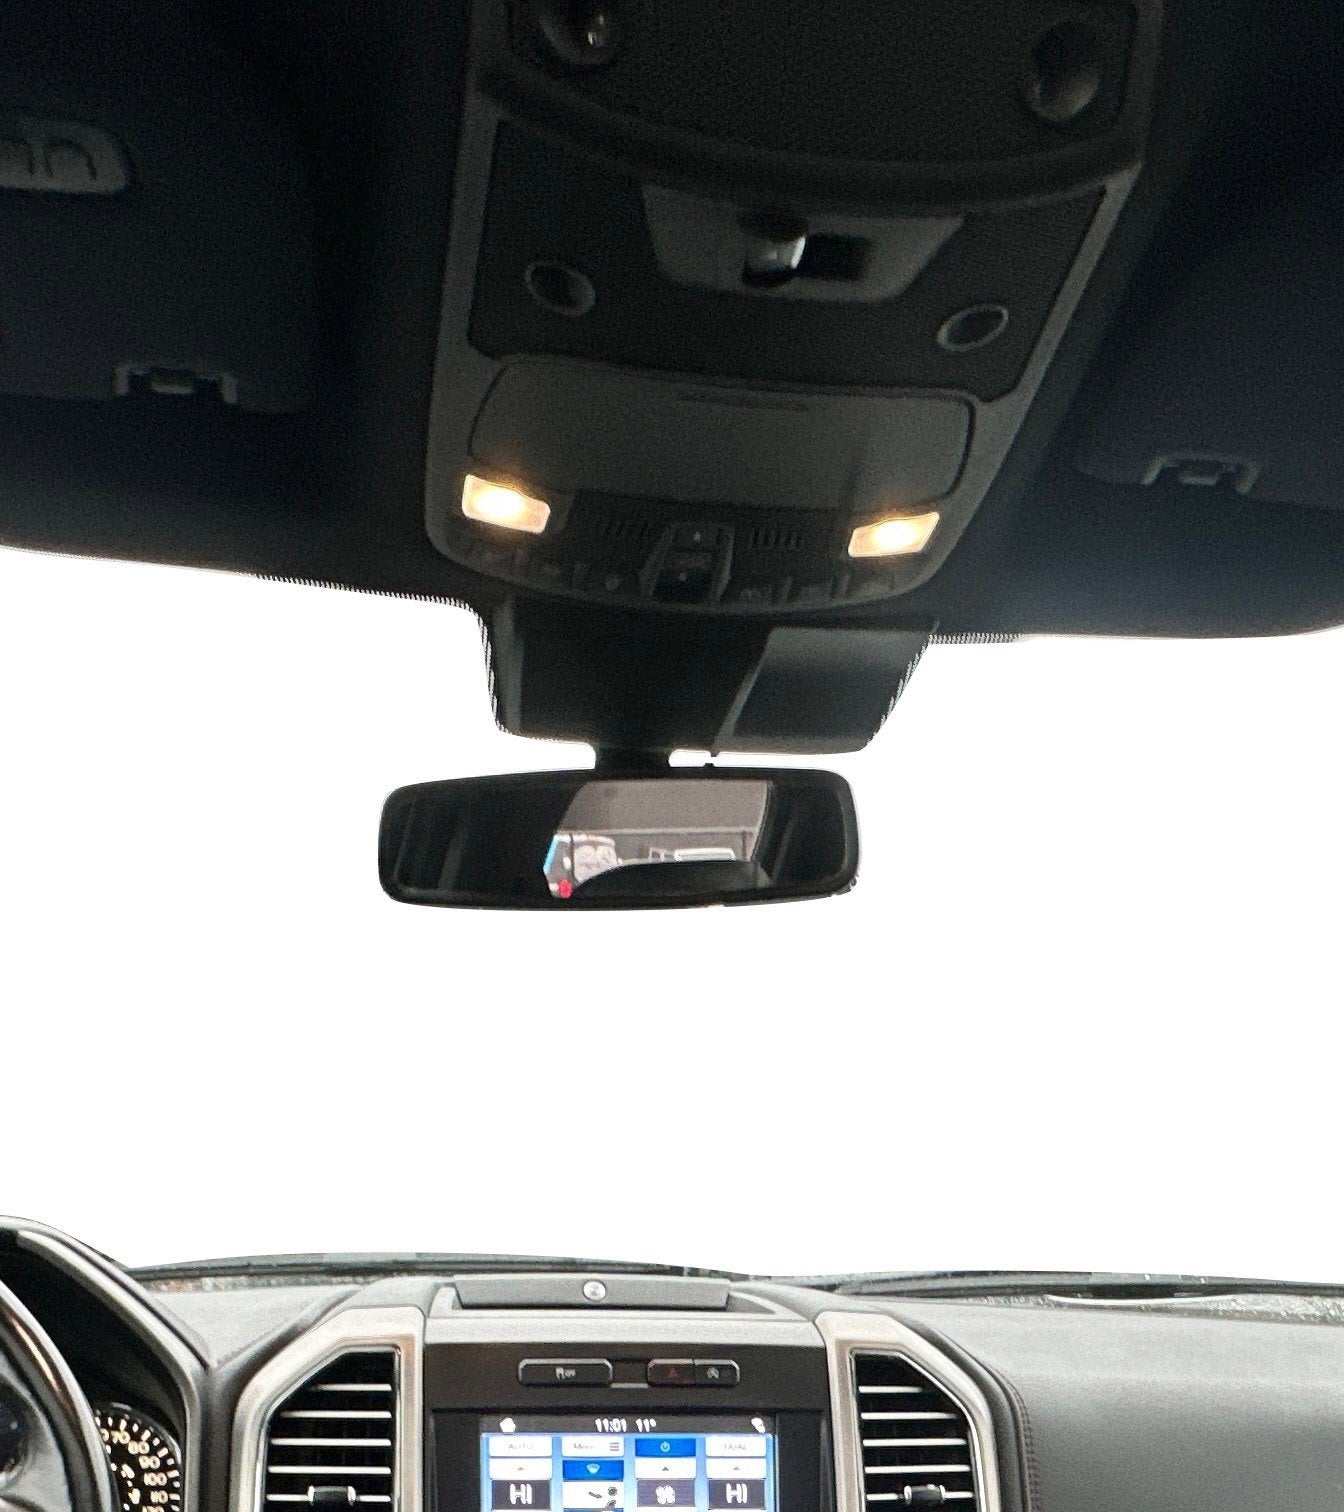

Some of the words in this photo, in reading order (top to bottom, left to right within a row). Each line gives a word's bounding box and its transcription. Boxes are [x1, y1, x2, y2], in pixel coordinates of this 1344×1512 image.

[594, 1418, 627, 1433] 11:01
[144, 1472, 168, 1487] 100
[509, 1483, 533, 1505] HI
[725, 1483, 748, 1504] HI
